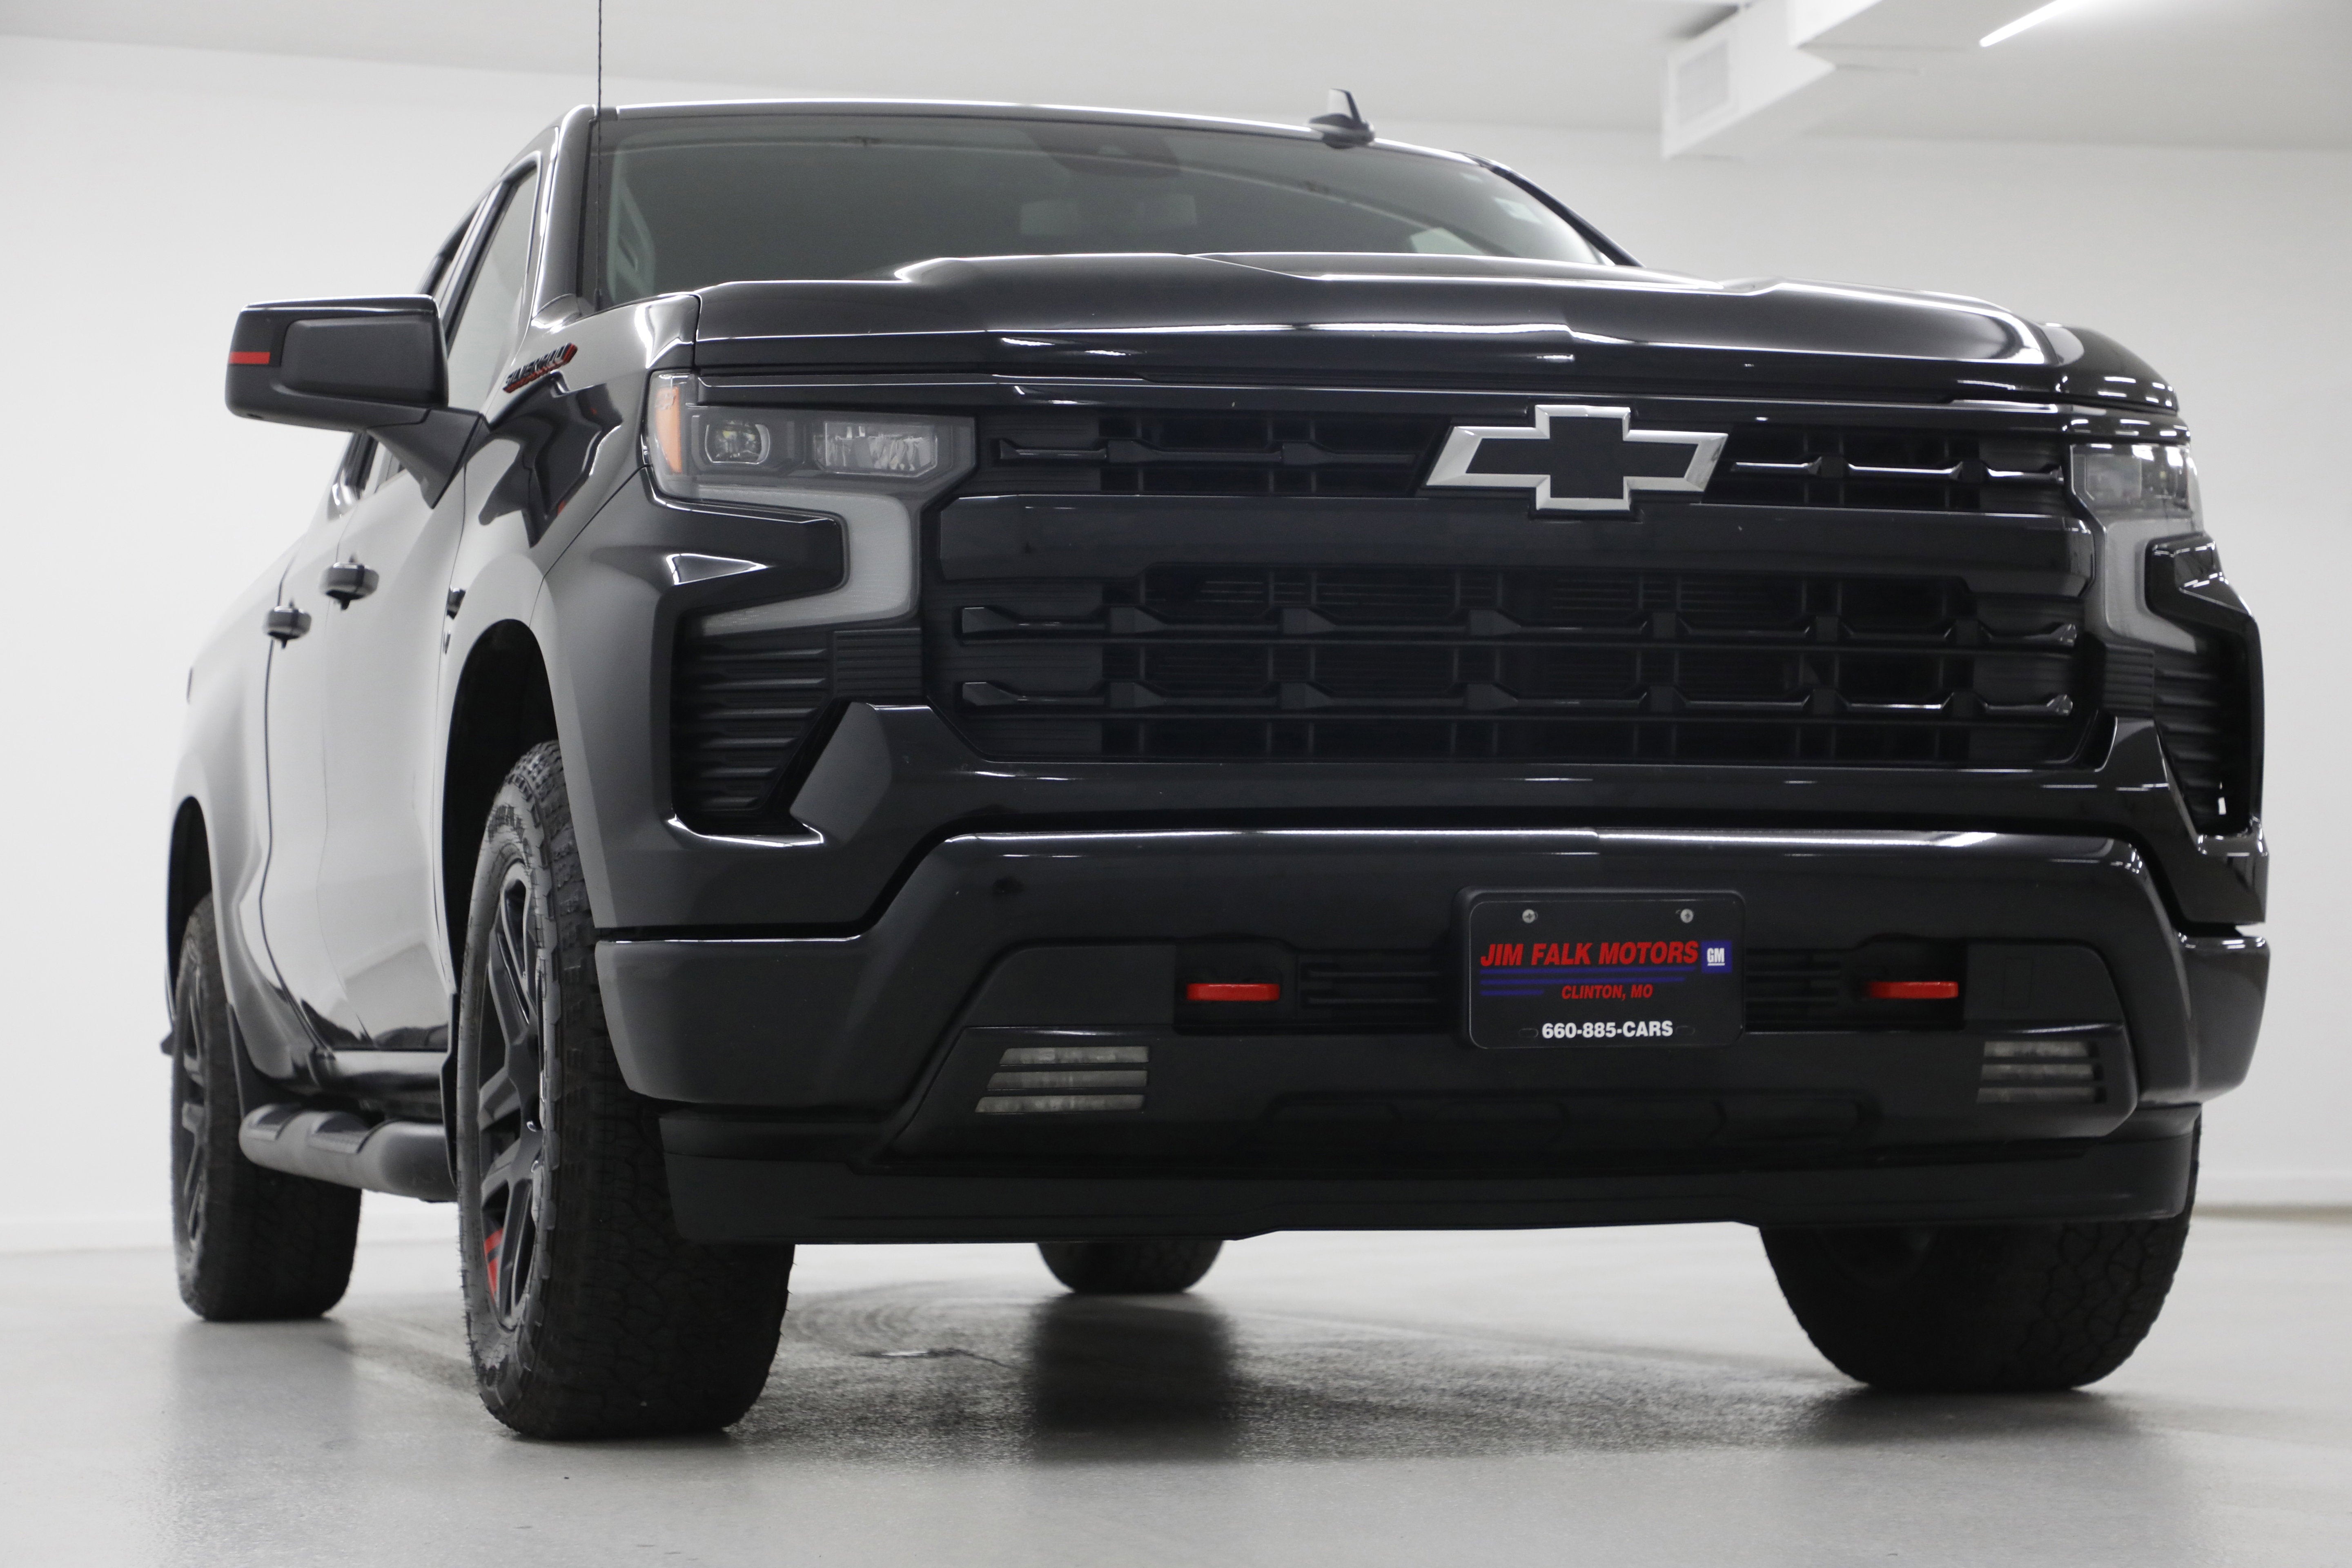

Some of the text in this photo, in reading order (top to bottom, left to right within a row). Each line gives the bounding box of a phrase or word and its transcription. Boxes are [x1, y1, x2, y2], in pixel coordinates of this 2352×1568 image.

[1480, 940, 1699, 967] JIM FALK MOTORS
[1706, 947, 1725, 964] GM
[1561, 984, 1653, 1000] CLINTON, MO
[1542, 1020, 1673, 1039] 660-885-CARS
